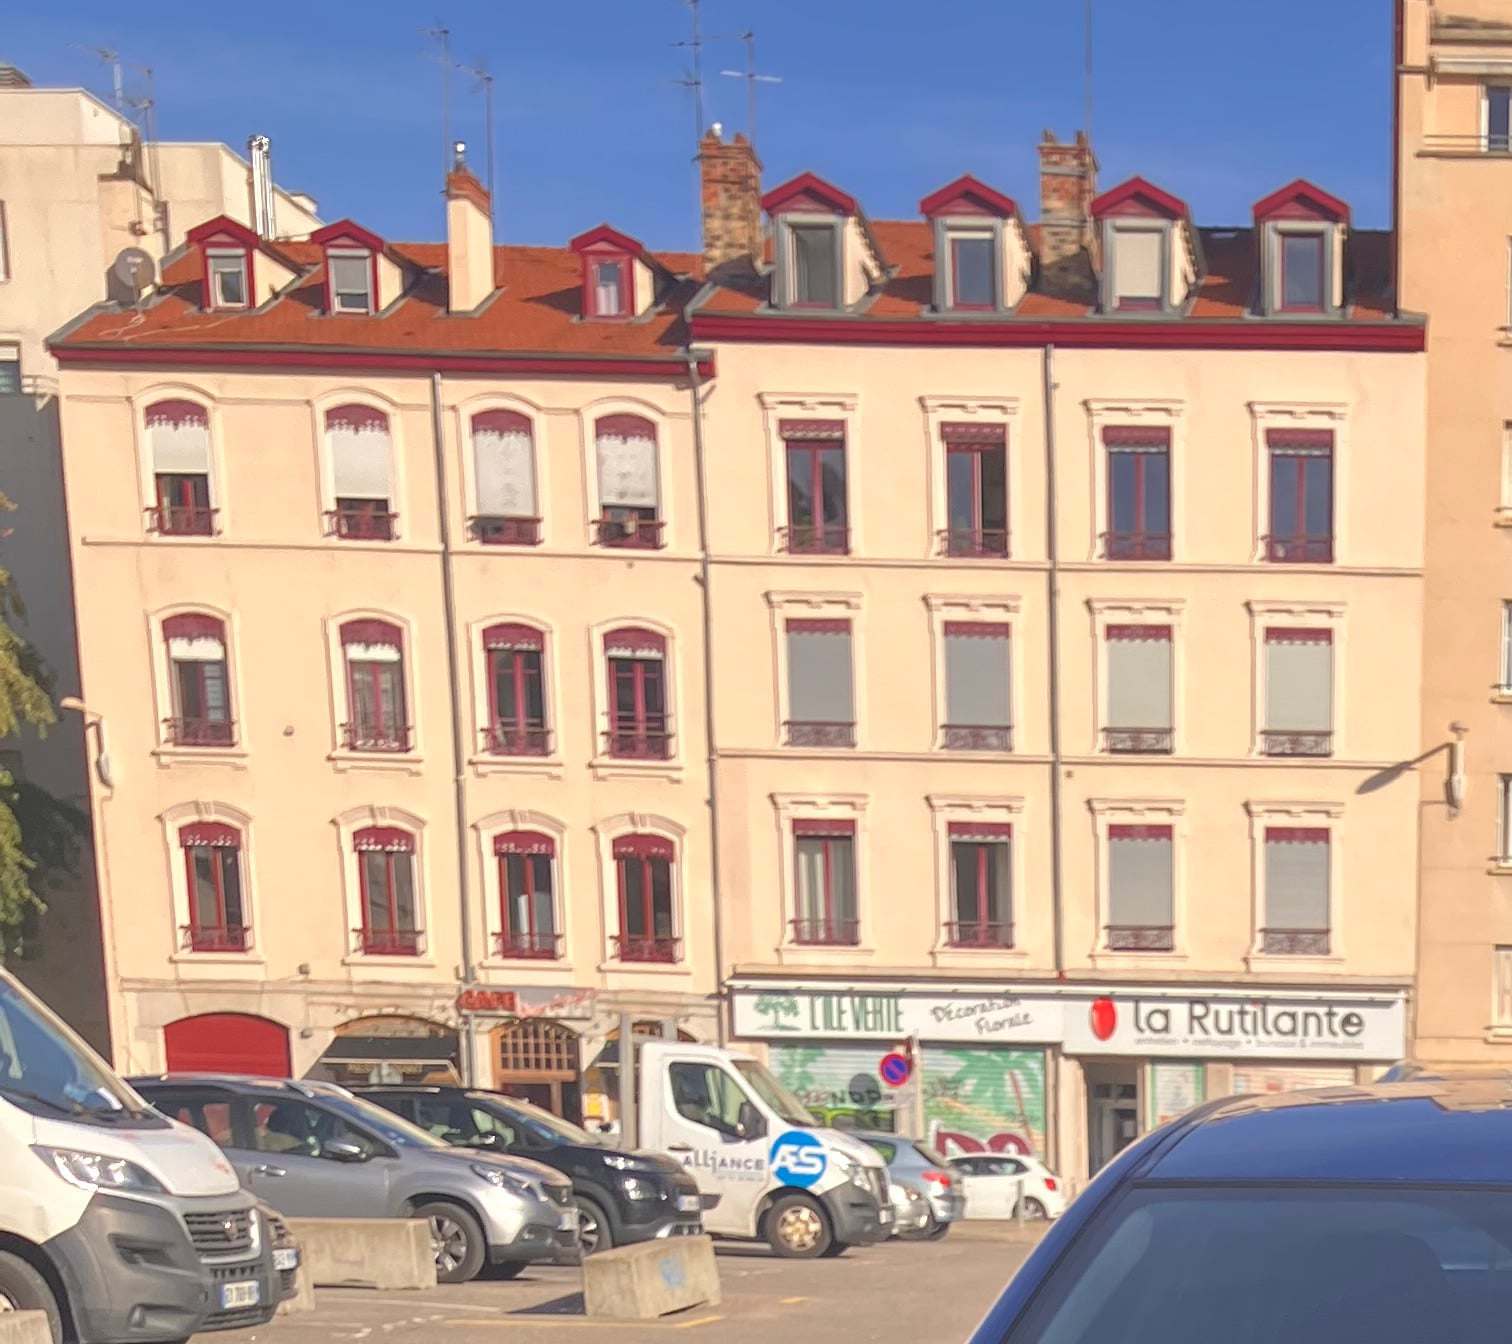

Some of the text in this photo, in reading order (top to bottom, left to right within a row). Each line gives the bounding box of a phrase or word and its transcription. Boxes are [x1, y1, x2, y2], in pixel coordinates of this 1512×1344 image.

[850, 996, 904, 1033] VERTE
[1133, 1000, 1364, 1037] la Rutilante
